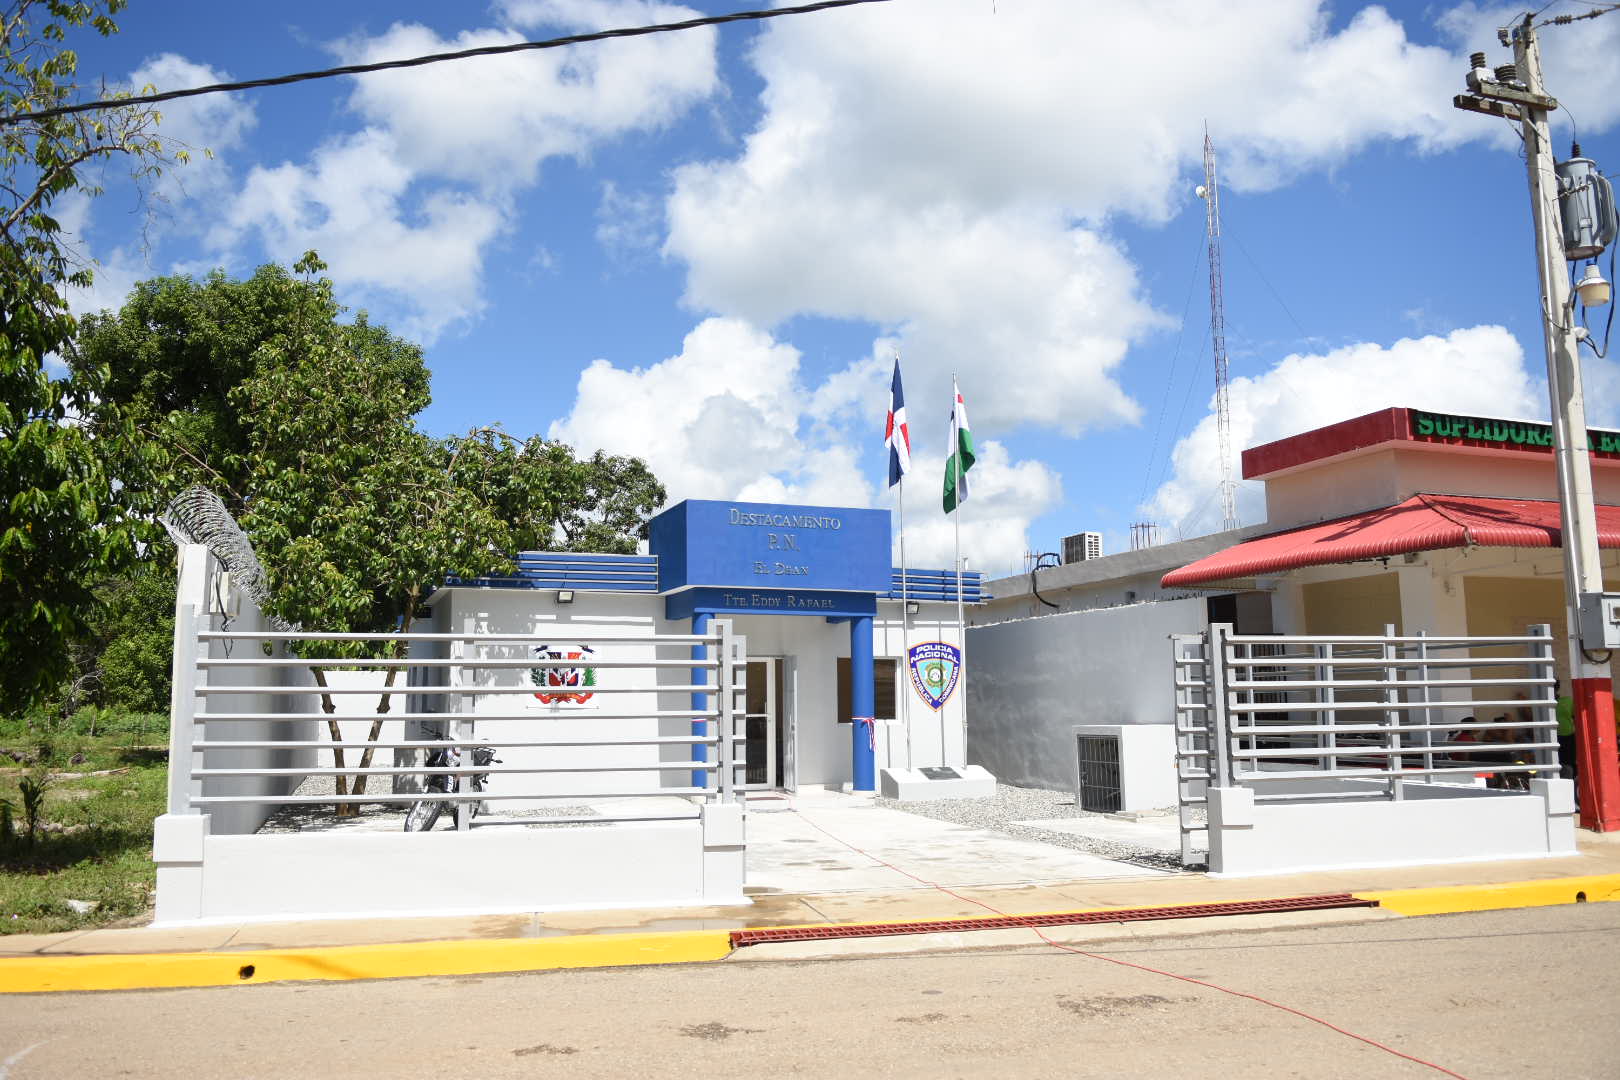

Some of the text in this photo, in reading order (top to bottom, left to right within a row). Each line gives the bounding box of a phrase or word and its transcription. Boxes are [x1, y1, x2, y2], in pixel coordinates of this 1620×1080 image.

[1416, 412, 1555, 446] SUPLIDORA
[728, 507, 841, 530] DESTACAMENTO
[751, 594, 781, 608] EDDY
[787, 595, 834, 609] RAFAEL
[910, 651, 959, 664] NACIONAL
[916, 644, 953, 655] POLICIA
[911, 667, 933, 704] REPUBLICA
[938, 666, 959, 703] DOMINICANA
